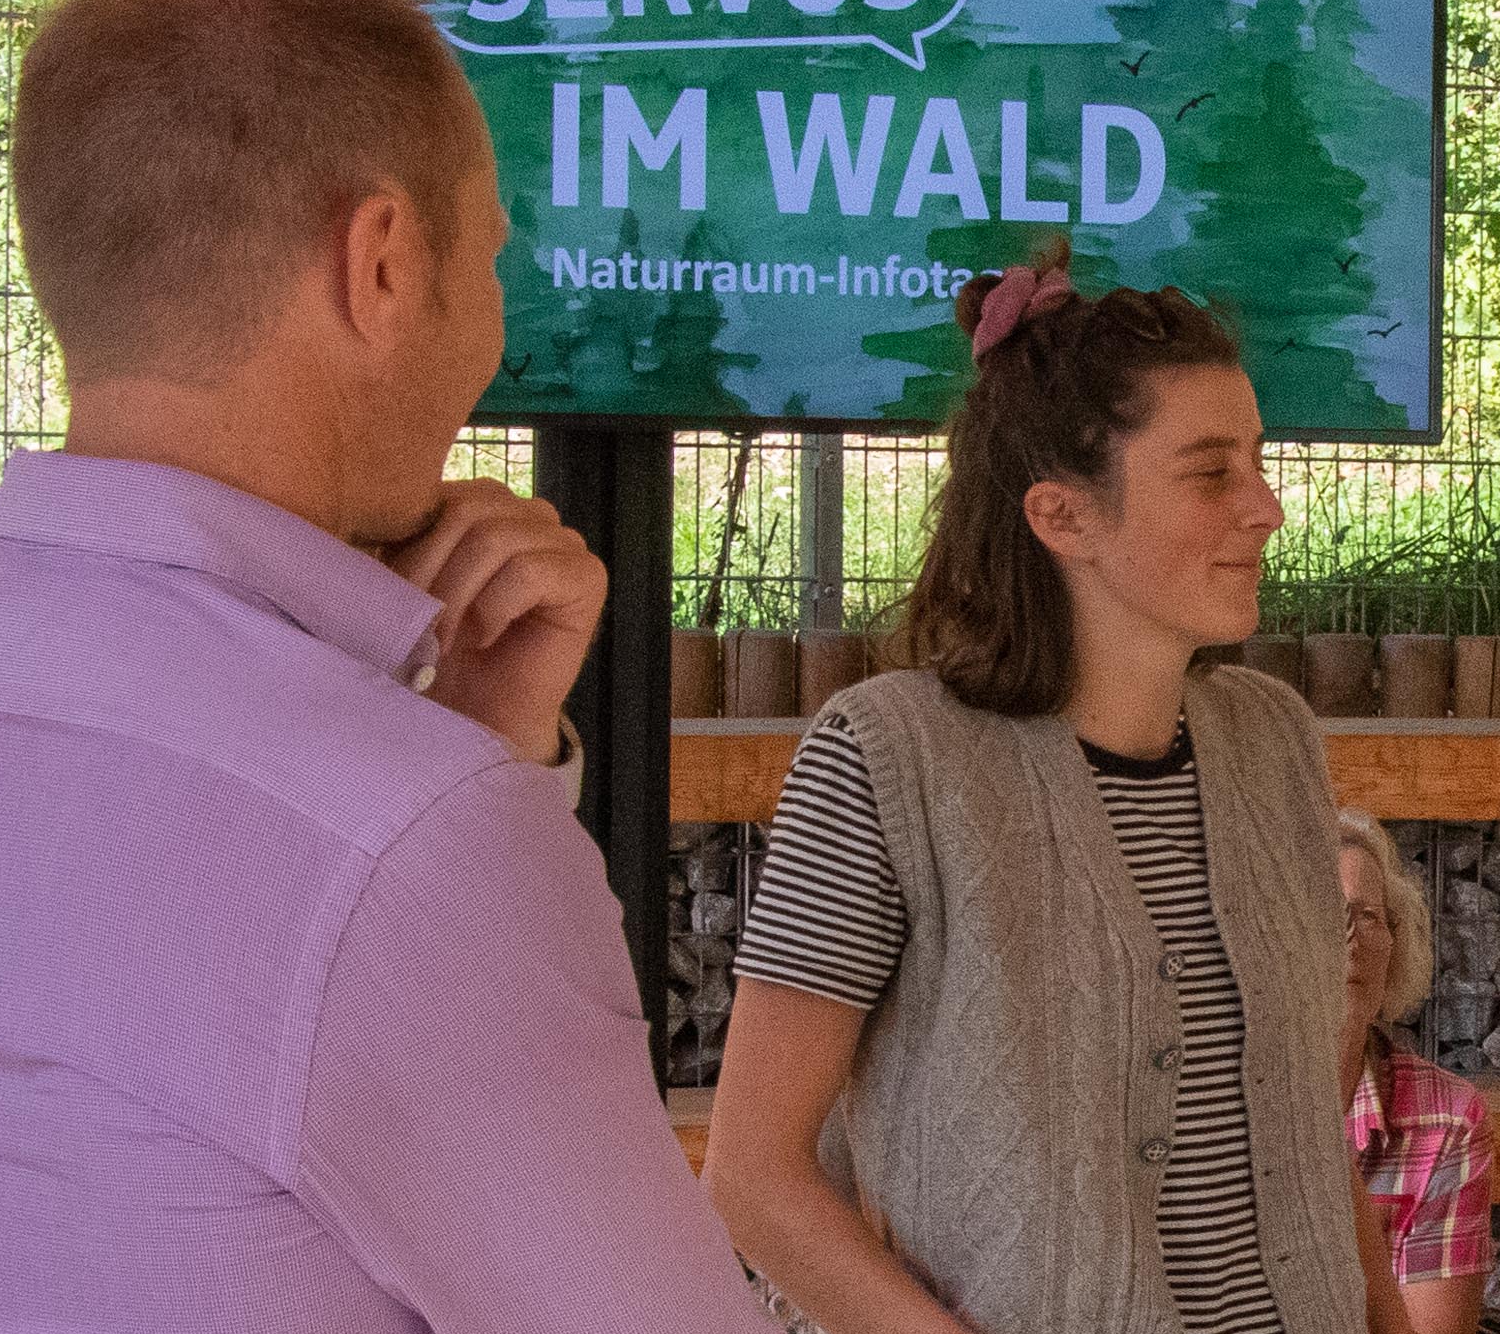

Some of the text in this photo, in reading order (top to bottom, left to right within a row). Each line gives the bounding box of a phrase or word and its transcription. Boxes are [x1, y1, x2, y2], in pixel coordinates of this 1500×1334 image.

[551, 82, 1166, 224] IM WALD
[552, 247, 1004, 299] Naturraum-Infota
